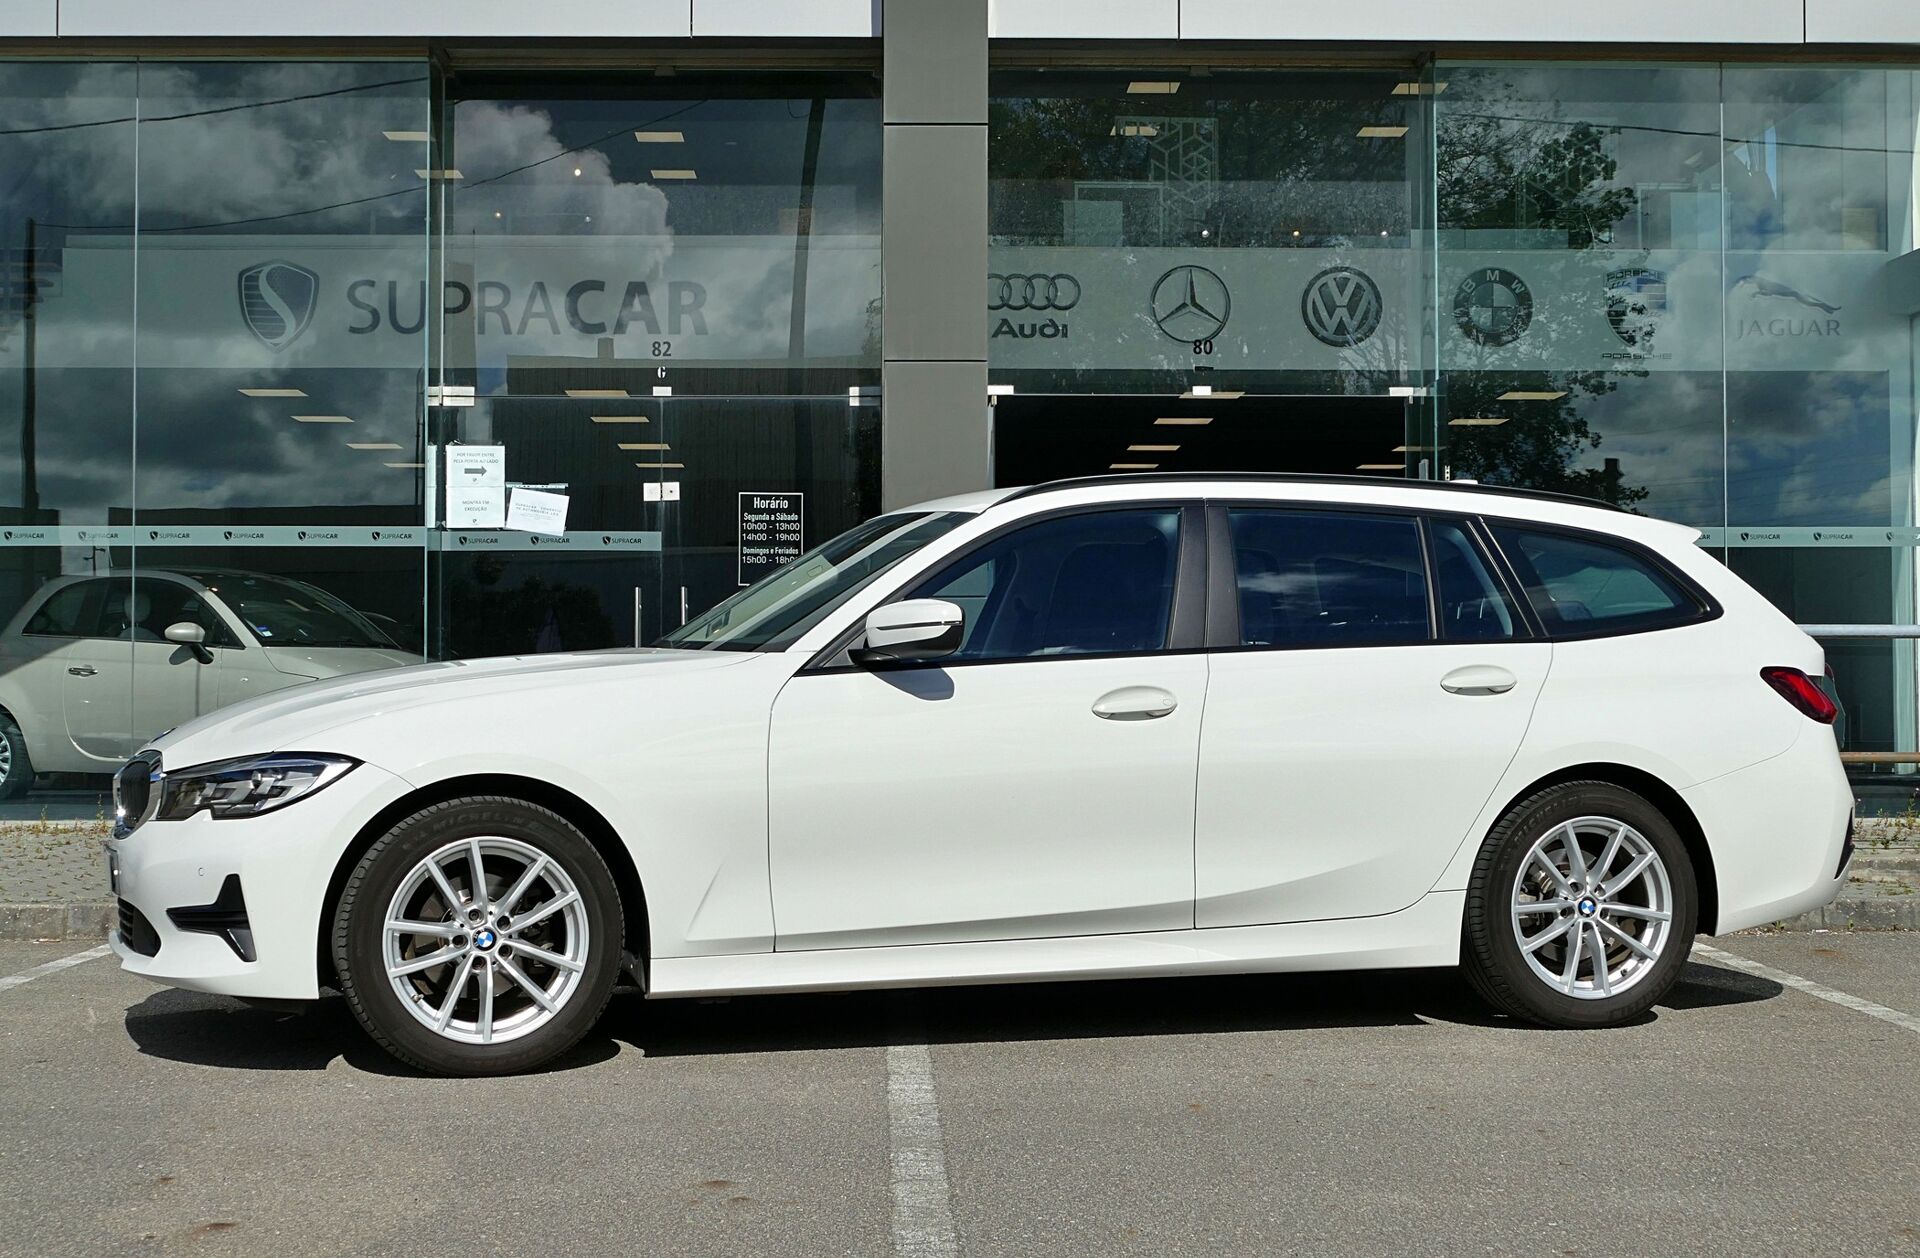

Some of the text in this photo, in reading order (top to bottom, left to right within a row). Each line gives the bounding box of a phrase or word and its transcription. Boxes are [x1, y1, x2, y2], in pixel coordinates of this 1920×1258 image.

[346, 279, 710, 336] SUPRACAR
[991, 318, 1068, 339] Audi
[1737, 318, 1842, 340] JAGUAR
[652, 341, 672, 357] 82
[1193, 339, 1213, 355] 80
[753, 496, 789, 509] Horário
[743, 512, 769, 522] Segunda
[775, 512, 798, 521] Sábado
[742, 522, 767, 531] 10h00
[775, 522, 800, 531] 13h00
[468, 537, 499, 545] SUPRACAR
[611, 537, 642, 545] SUPRACAR
[742, 533, 767, 541] 14h00
[775, 533, 800, 541] 19h00
[742, 546, 769, 556] Domingos
[742, 555, 767, 564] 15h00
[775, 555, 798, 564] 18h0
